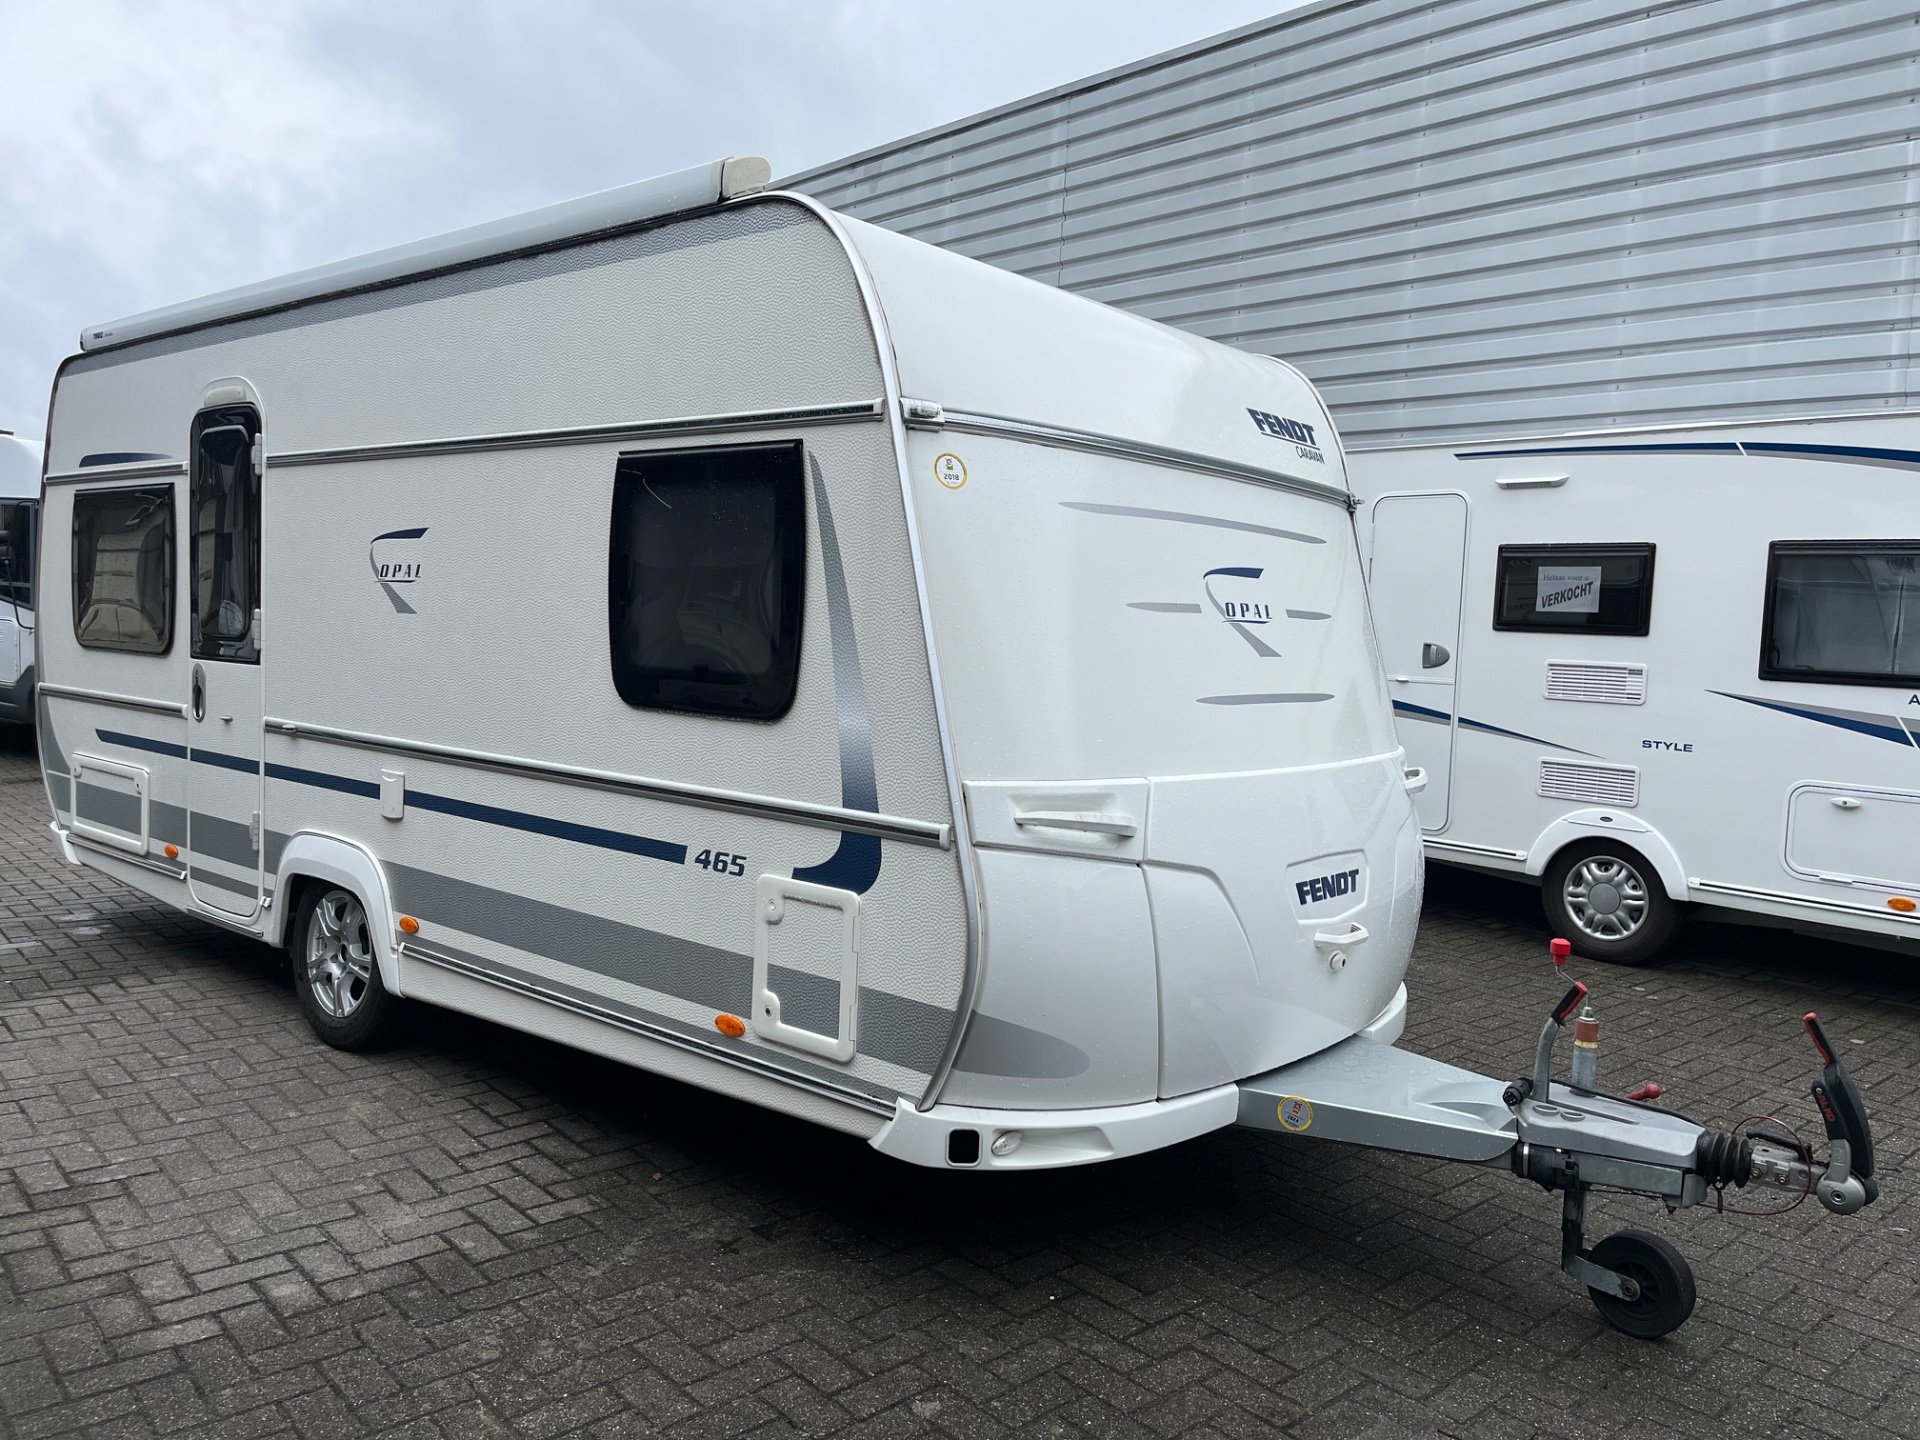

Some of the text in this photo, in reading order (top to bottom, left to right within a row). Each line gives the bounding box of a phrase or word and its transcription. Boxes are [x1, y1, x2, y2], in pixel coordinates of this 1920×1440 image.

[1245, 407, 1317, 447] FENDT
[1295, 445, 1326, 465] CARAVAN
[943, 473, 960, 481] 2018
[379, 564, 421, 578] OPAL
[1541, 581, 1594, 609] VERKOCHT
[1225, 602, 1273, 620] OPAL
[1642, 739, 1693, 753] STYLE
[694, 849, 747, 877] 465
[1295, 868, 1360, 906] FENDT
